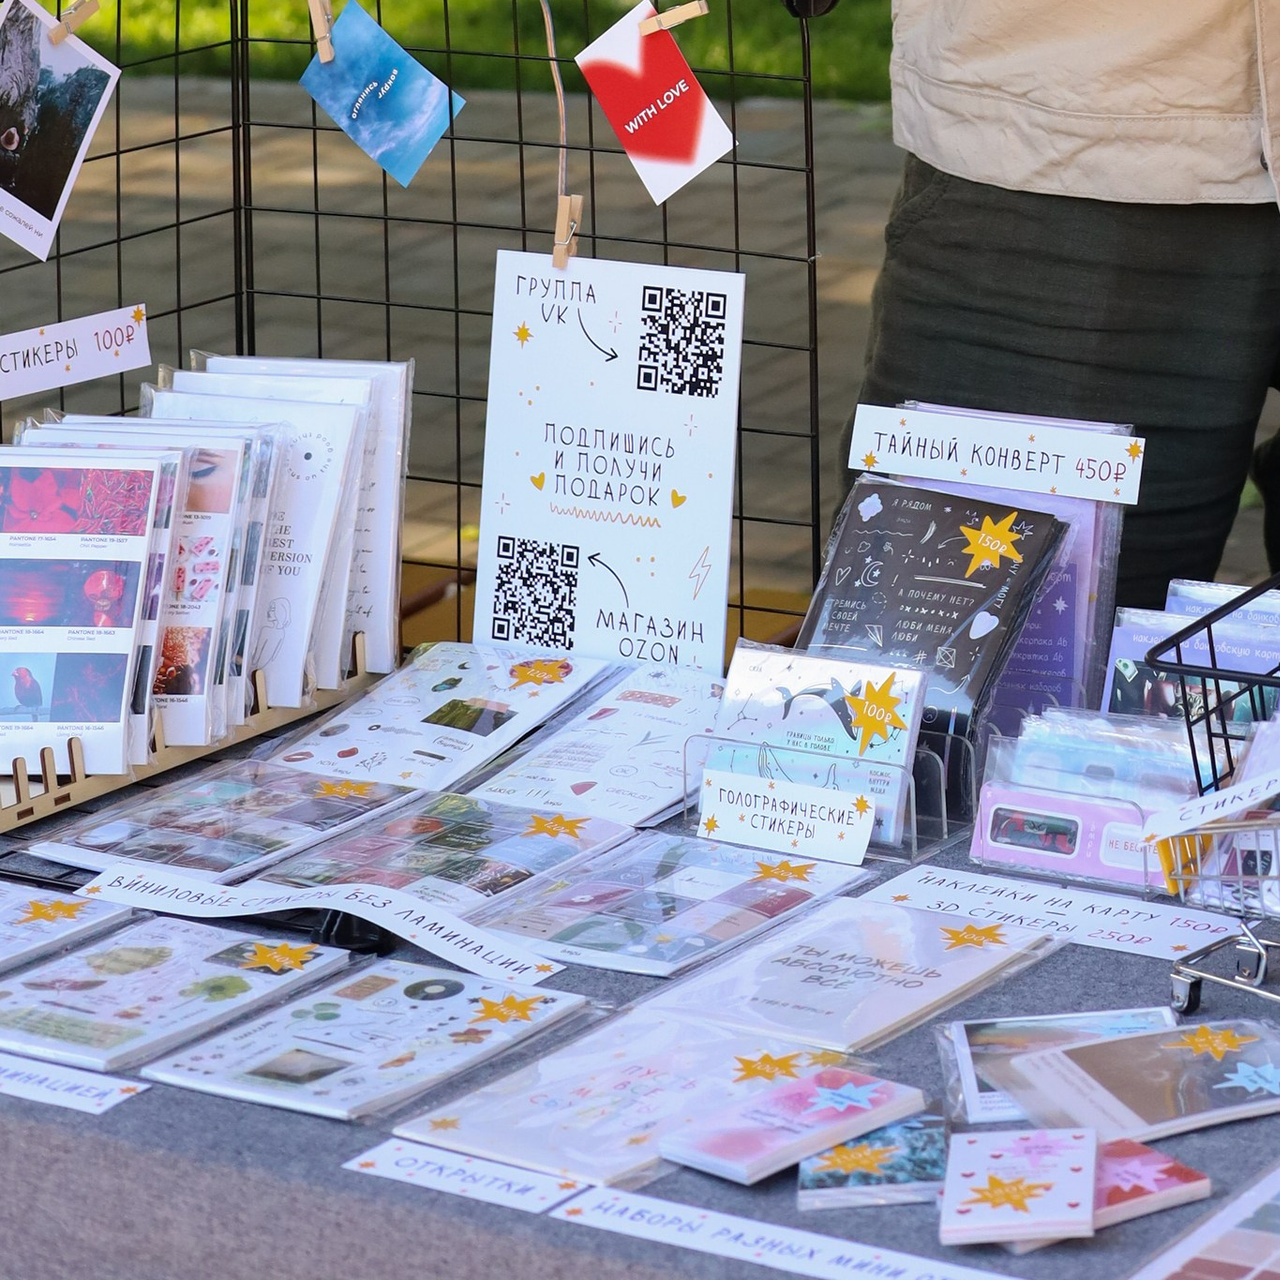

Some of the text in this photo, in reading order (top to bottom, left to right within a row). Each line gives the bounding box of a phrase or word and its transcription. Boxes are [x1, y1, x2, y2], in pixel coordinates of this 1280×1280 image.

[624, 79, 689, 134] WITH LOVE
[5, 208, 34, 233] сожалей
[516, 275, 597, 304] ГРУППА
[541, 303, 569, 324] VK
[0, 338, 79, 373] СТИКЕРЫ
[544, 422, 675, 459] ПОДПИШИСЬ
[873, 430, 960, 463] ТАЙНЫЙ
[971, 442, 1066, 475] КОНВЕРТ
[554, 450, 663, 482] И ПОЛУЧИ
[555, 474, 661, 507] ПОДАРОК
[901, 499, 932, 511] РЯДОМ
[907, 589, 946, 603] ПОЧЕМУ
[949, 596, 975, 607] НЕТ?
[596, 609, 704, 644] МАГАЗИН
[823, 621, 851, 633] МЕЧТЕ
[831, 610, 858, 622] СВОЕЙ
[895, 620, 924, 631] ЛЮБИ
[619, 638, 679, 665] OZON
[891, 632, 919, 643] ЛЮБИ
[719, 787, 855, 826] ГОЛОГРАФИЧЕСКИЕ
[751, 813, 816, 839] СТИКЕРЫ
[1108, 839, 1121, 851] НЕ
[917, 874, 1038, 903] НАКЛЕЙКИ
[1044, 896, 1074, 909] НА
[1082, 904, 1162, 923] КАРТУ
[107, 875, 237, 908] ВИНИЛОВЫЕ
[241, 889, 337, 911] СТИКЕРЫ
[344, 889, 393, 910] БЕЗ
[394, 909, 533, 975] ЛАМИНАЦИИ
[926, 900, 959, 913] 3D
[968, 907, 1078, 934] СТИКЕРЫ
[771, 956, 924, 989] АБСОЛЮТНО
[792, 944, 942, 978] ТЫ МОЖЕШЬ
[393, 1155, 537, 1199] ОТКРЫТКИ
[589, 1197, 704, 1236] НАБОРЫ
[714, 1225, 821, 1261] РАЗНЫХ
